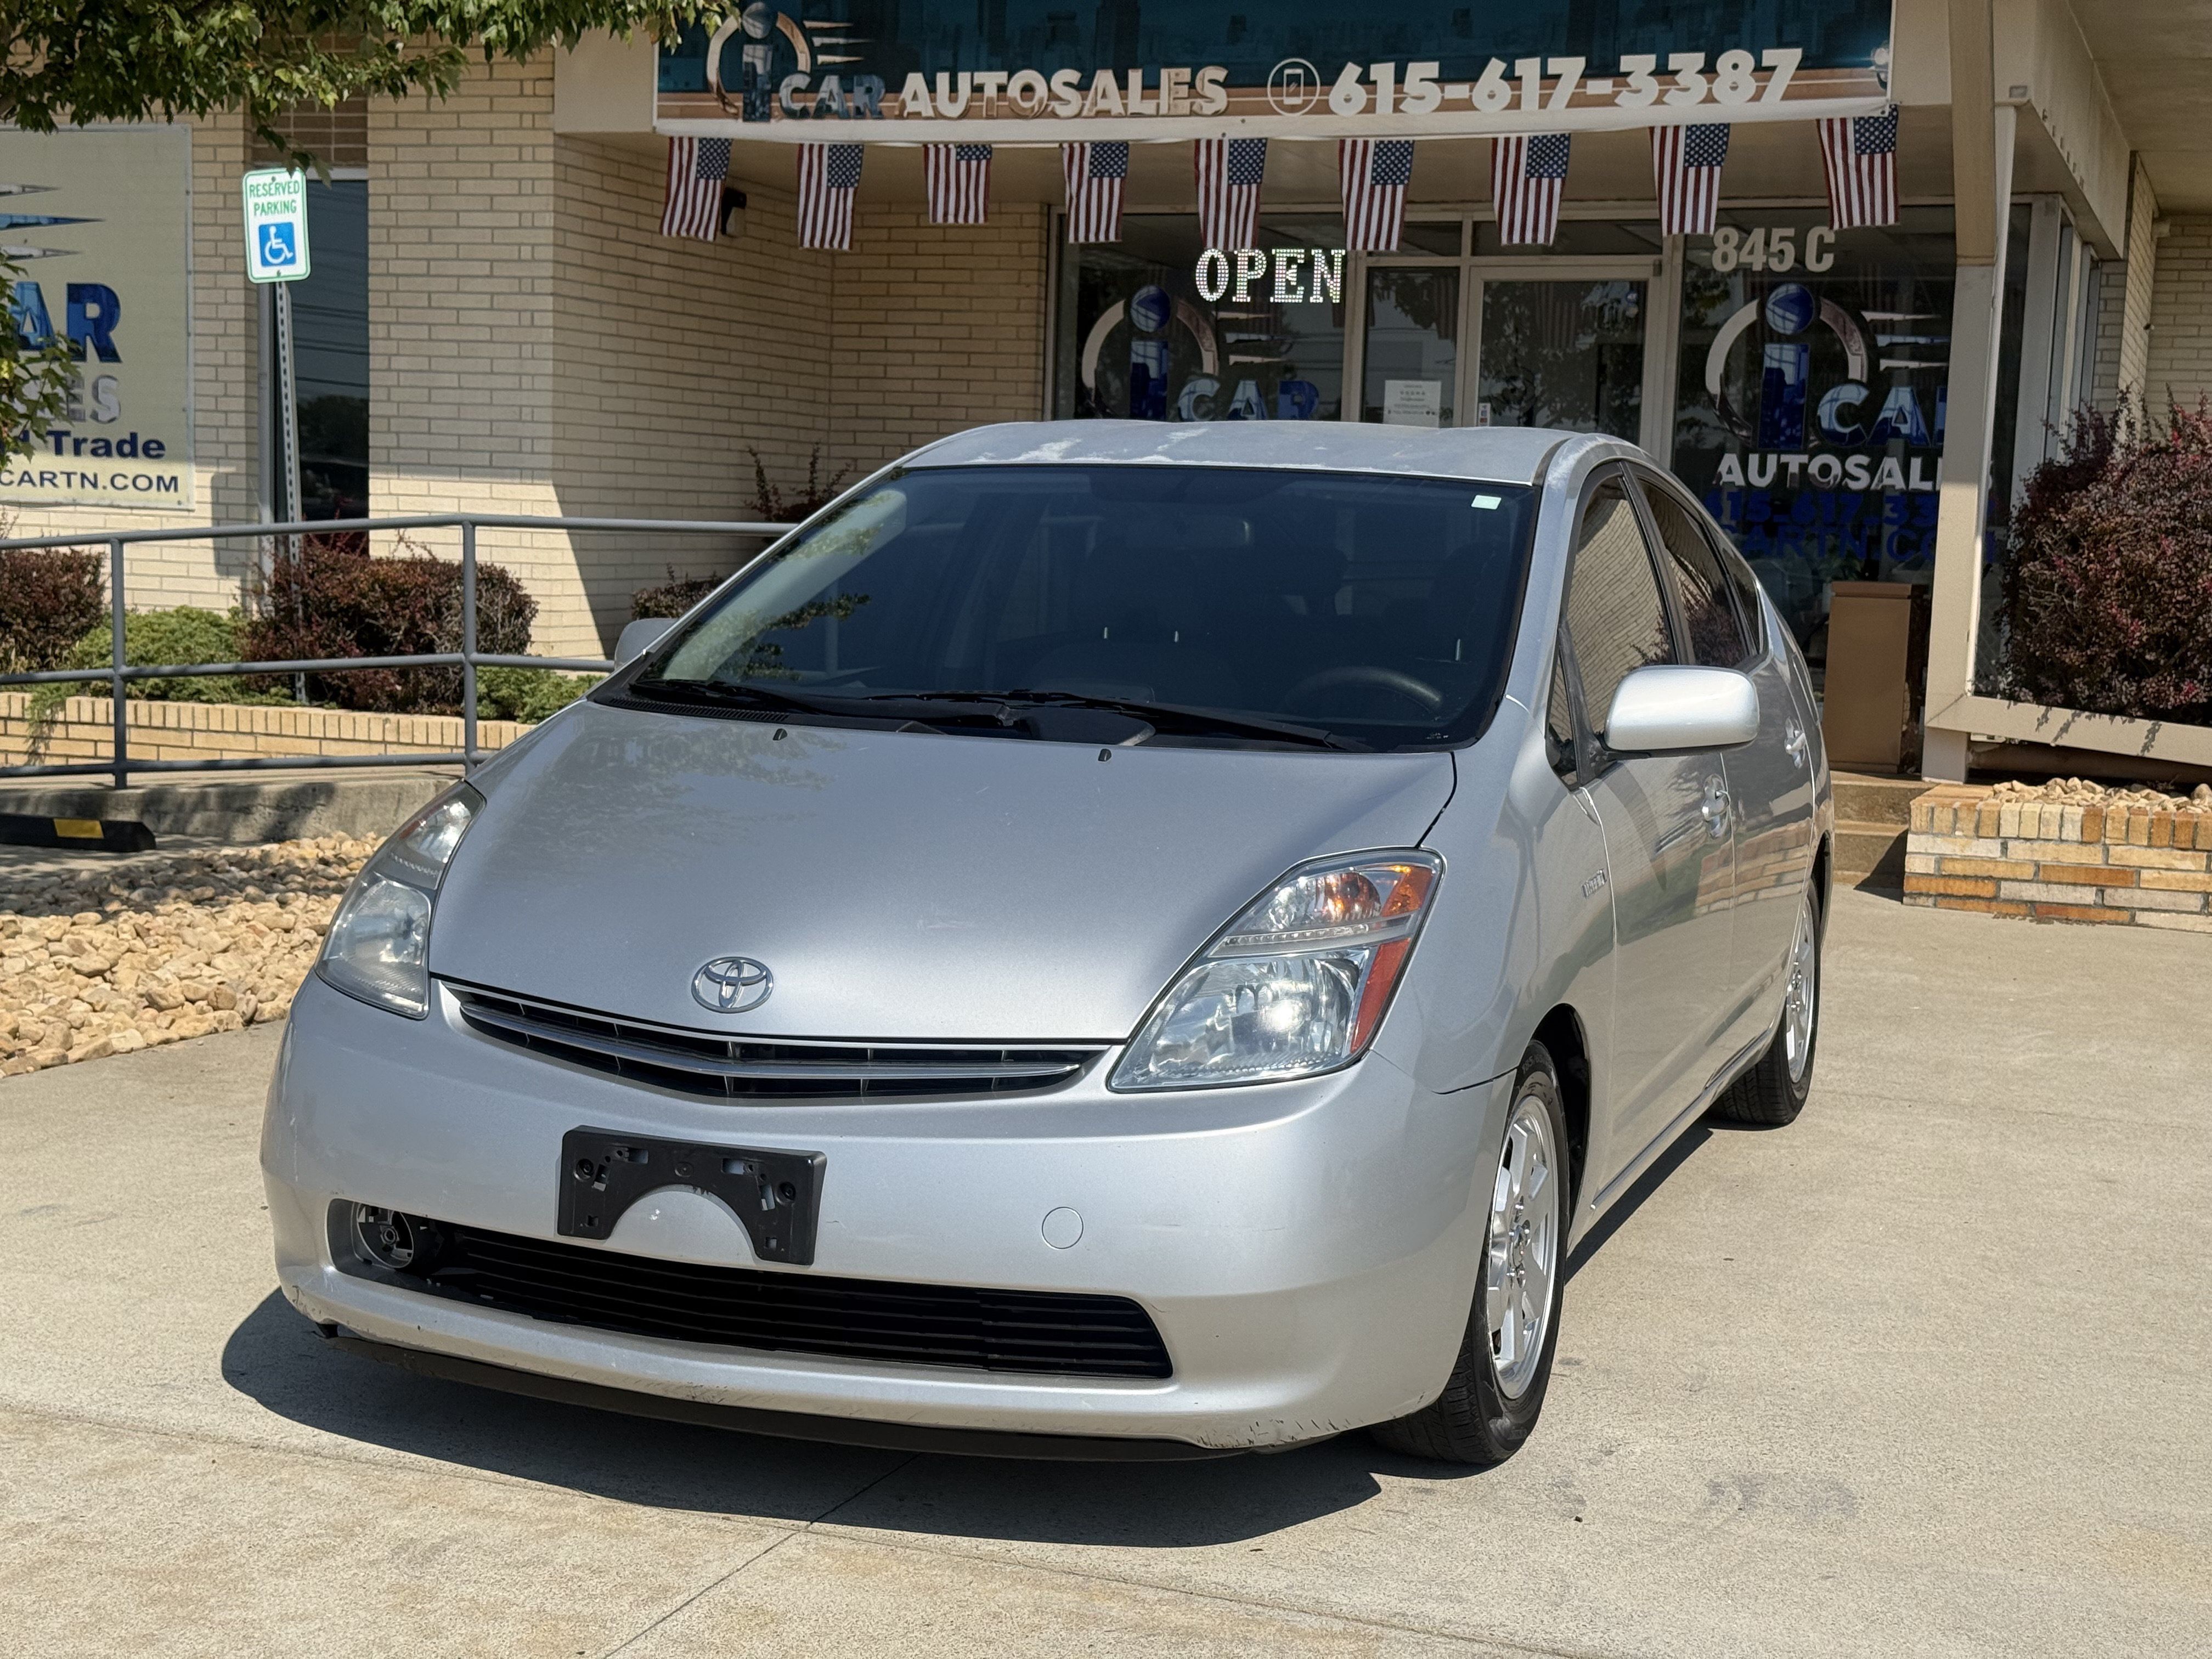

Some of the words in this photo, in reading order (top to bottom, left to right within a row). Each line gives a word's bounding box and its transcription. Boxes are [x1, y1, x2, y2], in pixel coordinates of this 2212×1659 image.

[779, 73, 887, 119] CAR
[894, 66, 1229, 119] AUTOSALES
[1329, 48, 1803, 115] 615-617-3387
[249, 180, 300, 198] RESERVED
[253, 199, 297, 216] PARKING
[1711, 226, 1795, 272] 845
[1805, 226, 1836, 273] C
[1195, 248, 1346, 303] OPEN
[1817, 383, 1948, 447] CA
[46, 430, 167, 459] Trade
[0, 470, 179, 493] CARTN.COM
[1713, 453, 1943, 491] AUTOSAL
[1723, 524, 1935, 562] ARTN.C
